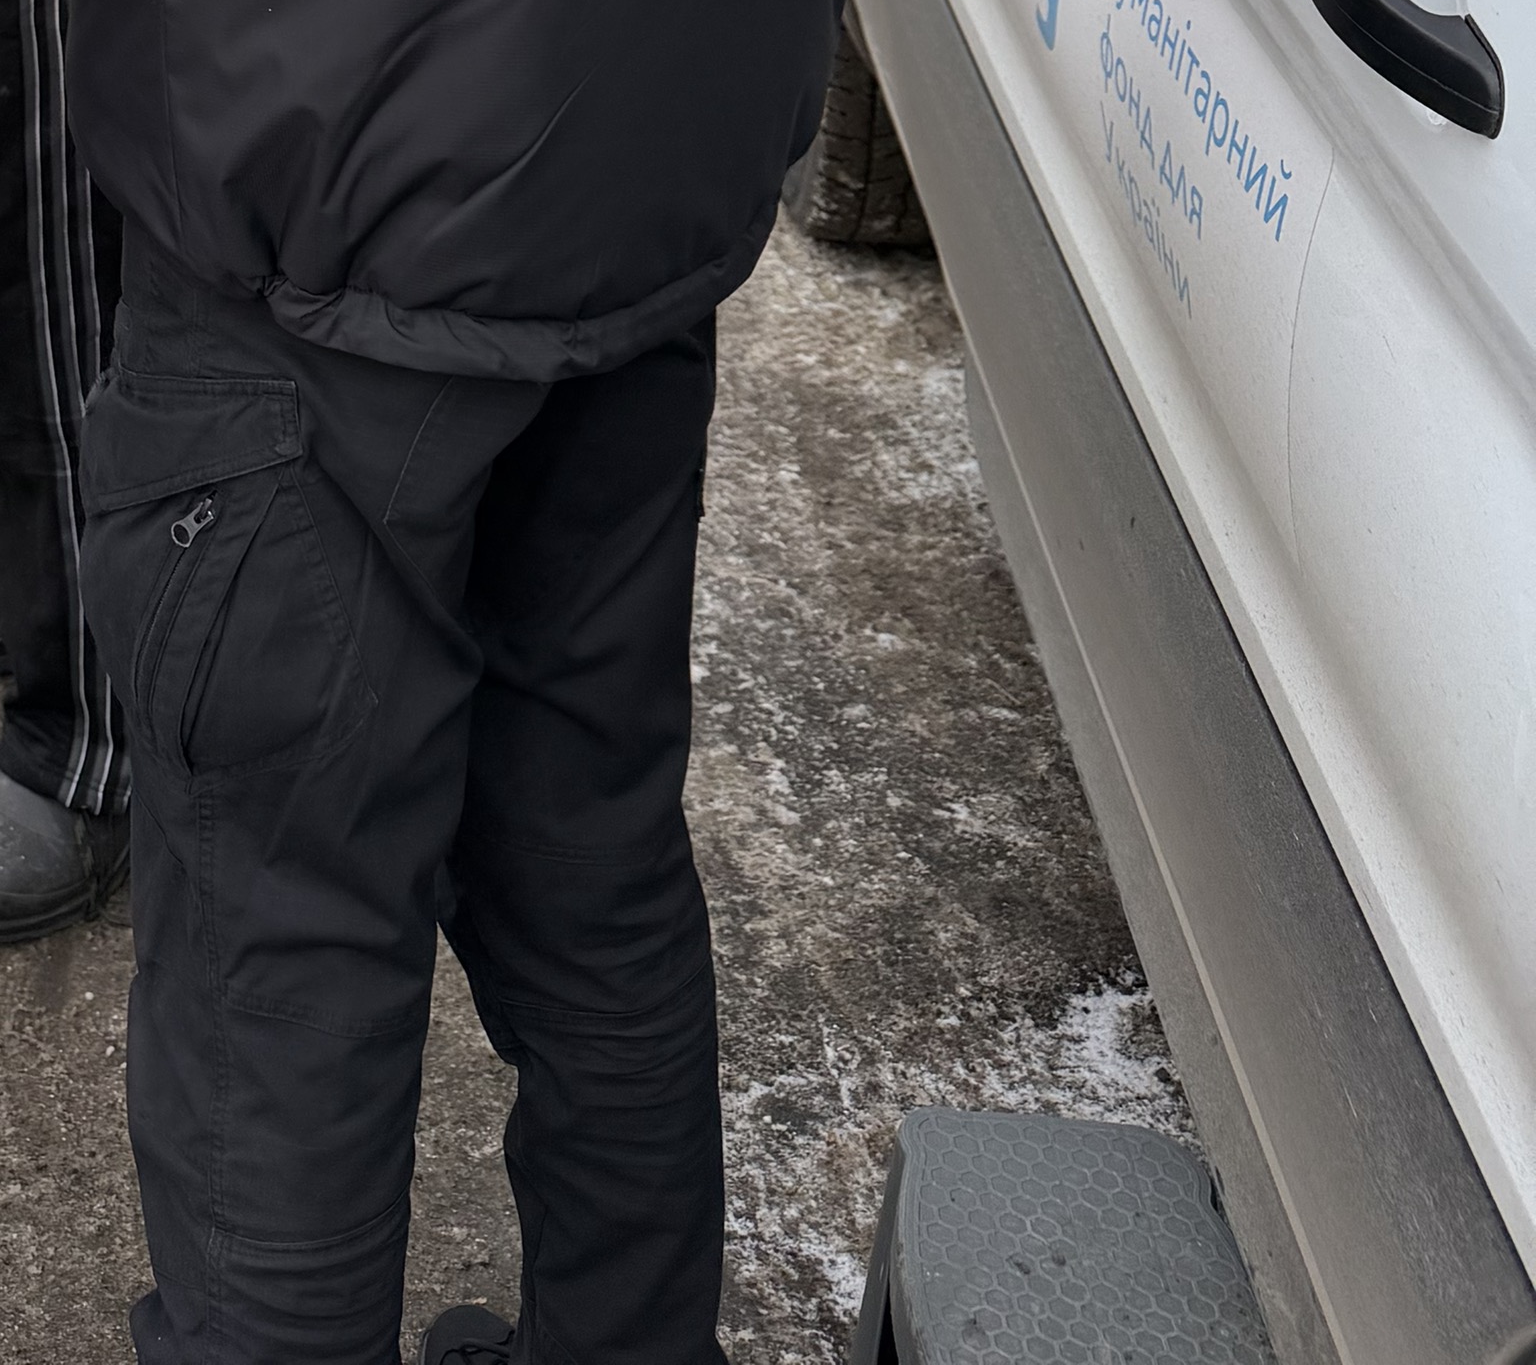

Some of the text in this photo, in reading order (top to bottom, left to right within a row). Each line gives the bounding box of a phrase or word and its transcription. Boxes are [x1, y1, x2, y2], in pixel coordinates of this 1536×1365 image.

[1100, 13, 1204, 241] фонд для
[1100, 100, 1193, 320] України
